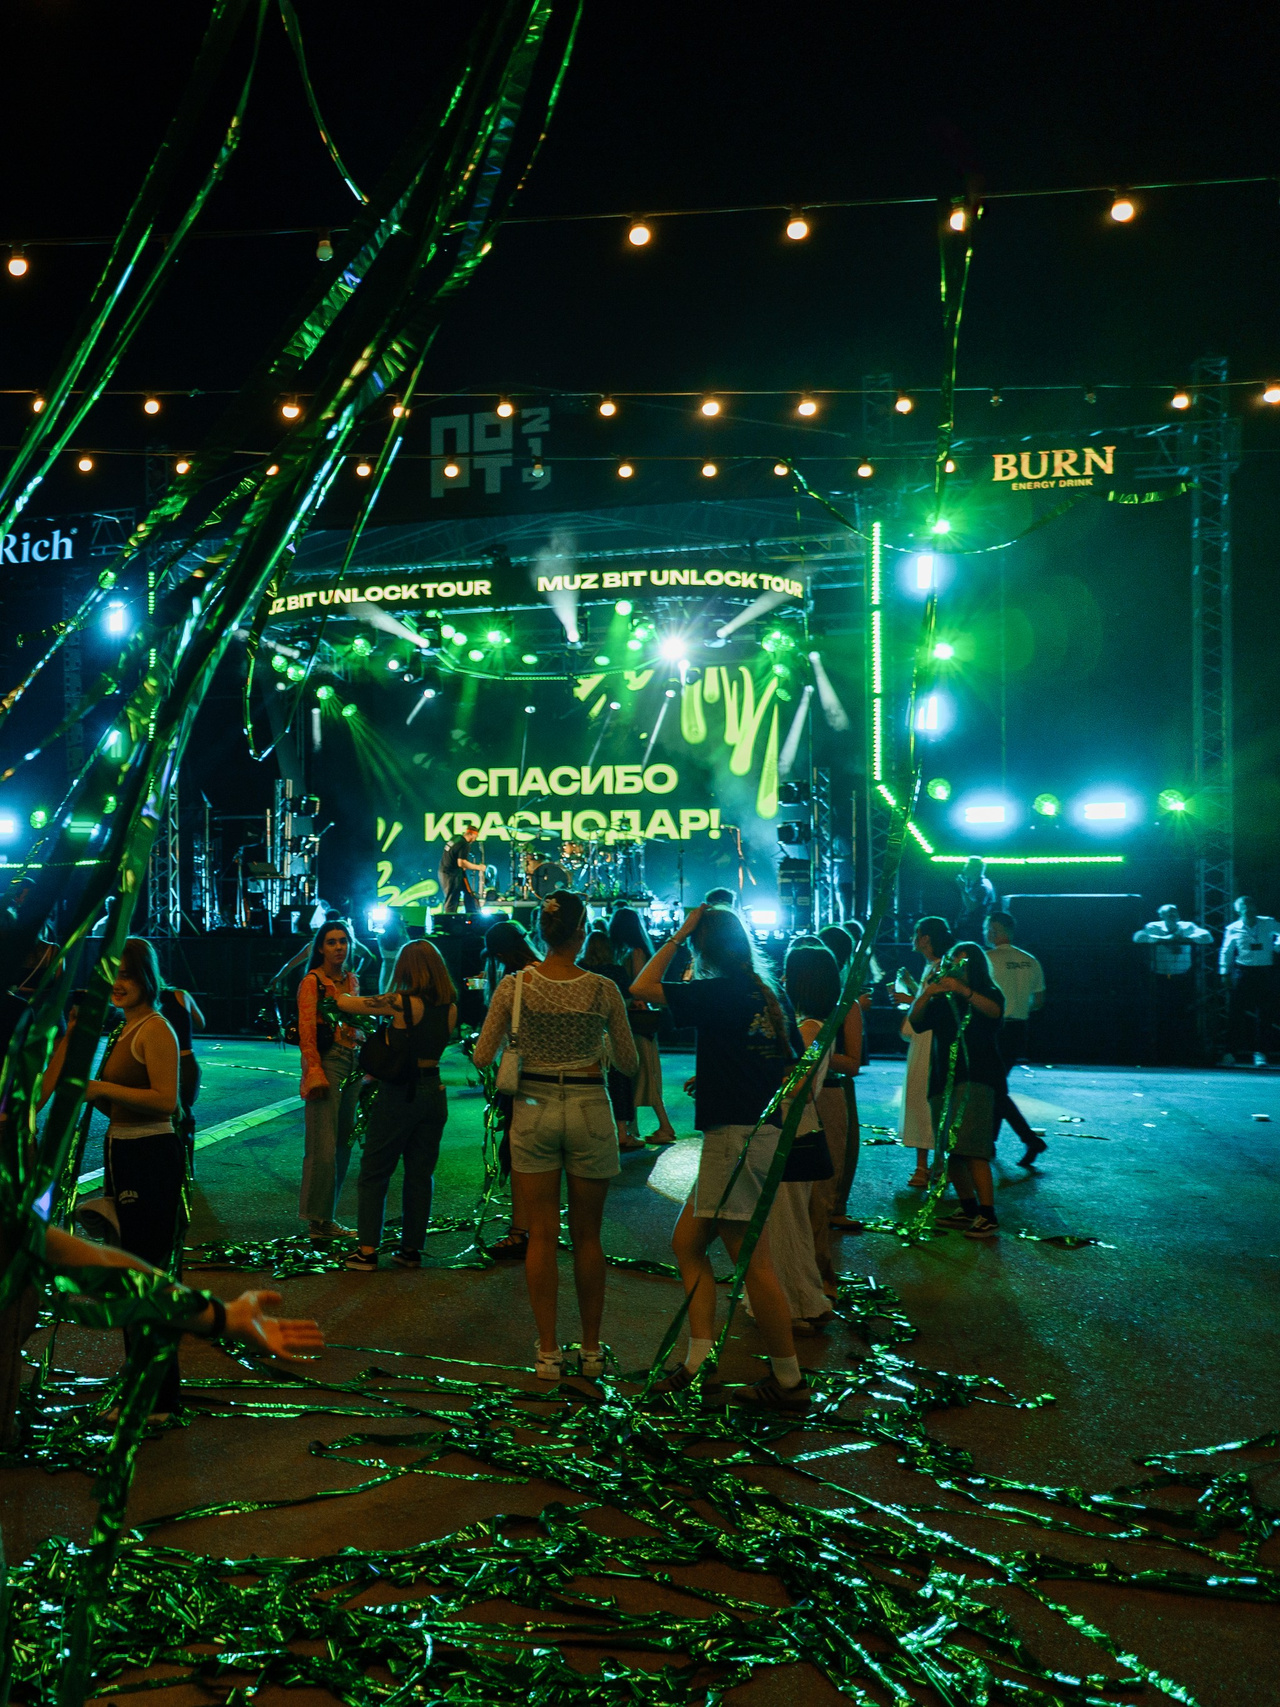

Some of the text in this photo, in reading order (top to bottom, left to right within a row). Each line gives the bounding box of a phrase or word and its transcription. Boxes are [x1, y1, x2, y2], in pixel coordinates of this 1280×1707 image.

[992, 445, 1117, 481] BURN
[1011, 478, 1094, 491] ENERGY DRINK
[286, 591, 319, 611] BIT
[318, 583, 421, 606] UNLOCK
[420, 579, 493, 599] TOUR
[537, 569, 804, 599] MUZ BIT UNLOCK TOUR
[456, 763, 679, 798] СПАСИБО
[424, 808, 722, 847] КРАСНОДАР!
